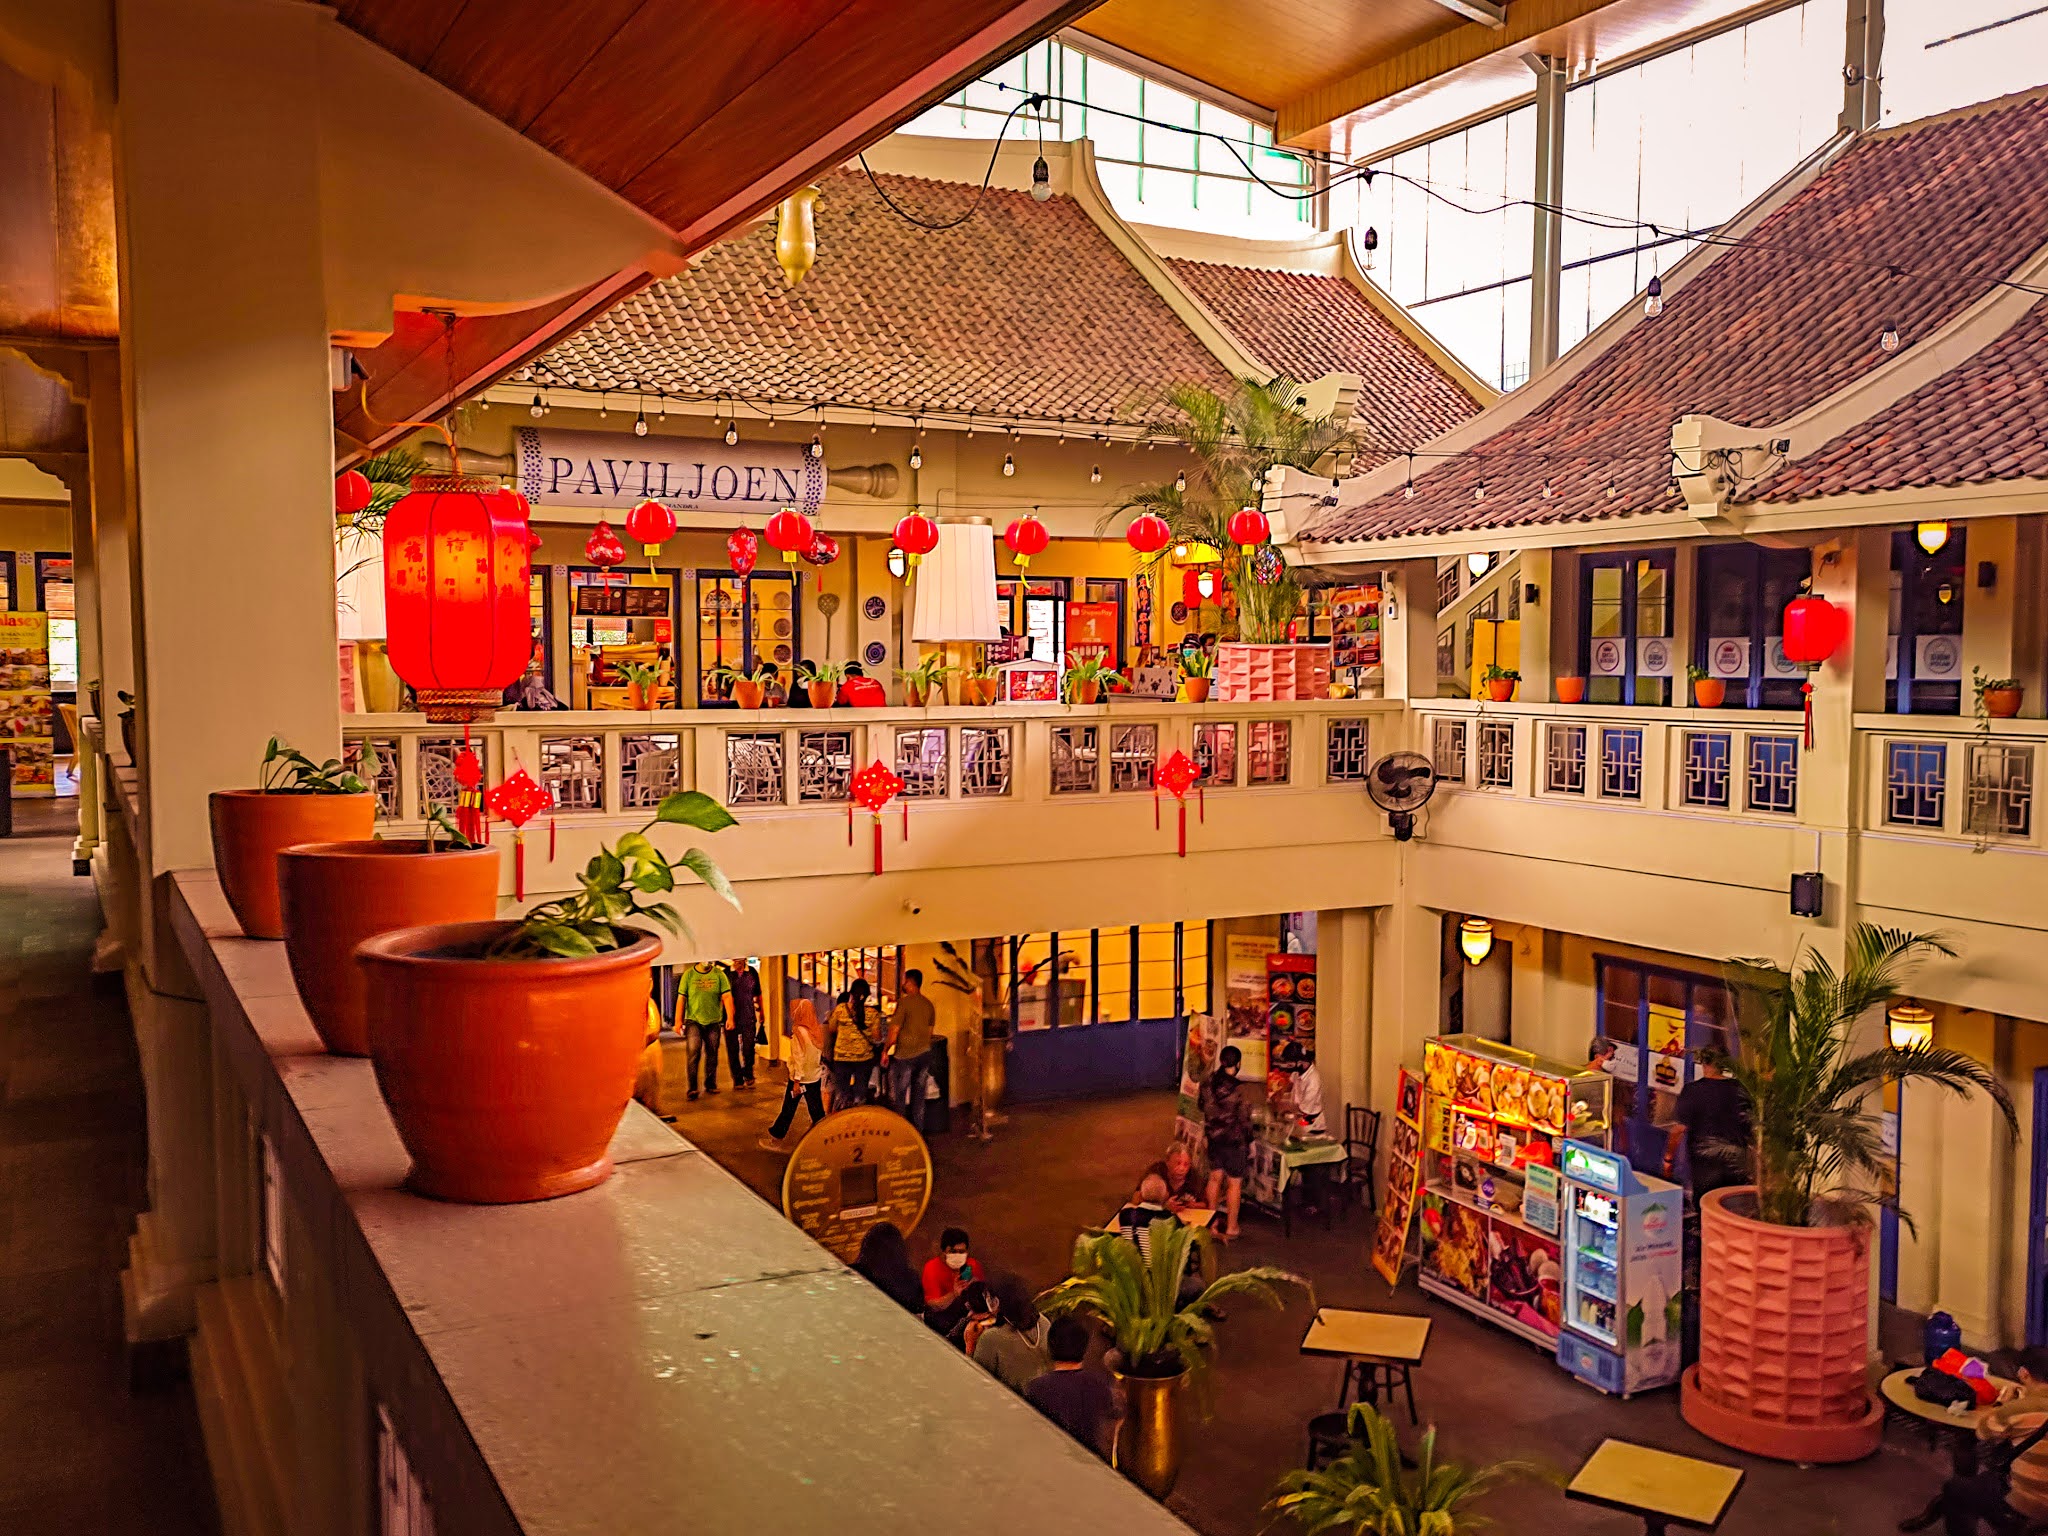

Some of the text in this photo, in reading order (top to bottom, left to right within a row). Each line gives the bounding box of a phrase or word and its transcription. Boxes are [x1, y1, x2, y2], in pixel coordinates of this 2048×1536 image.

[547, 456, 802, 503] PAVILJOEN
[823, 1130, 857, 1146] PETAK
[853, 1147, 864, 1163] 2
